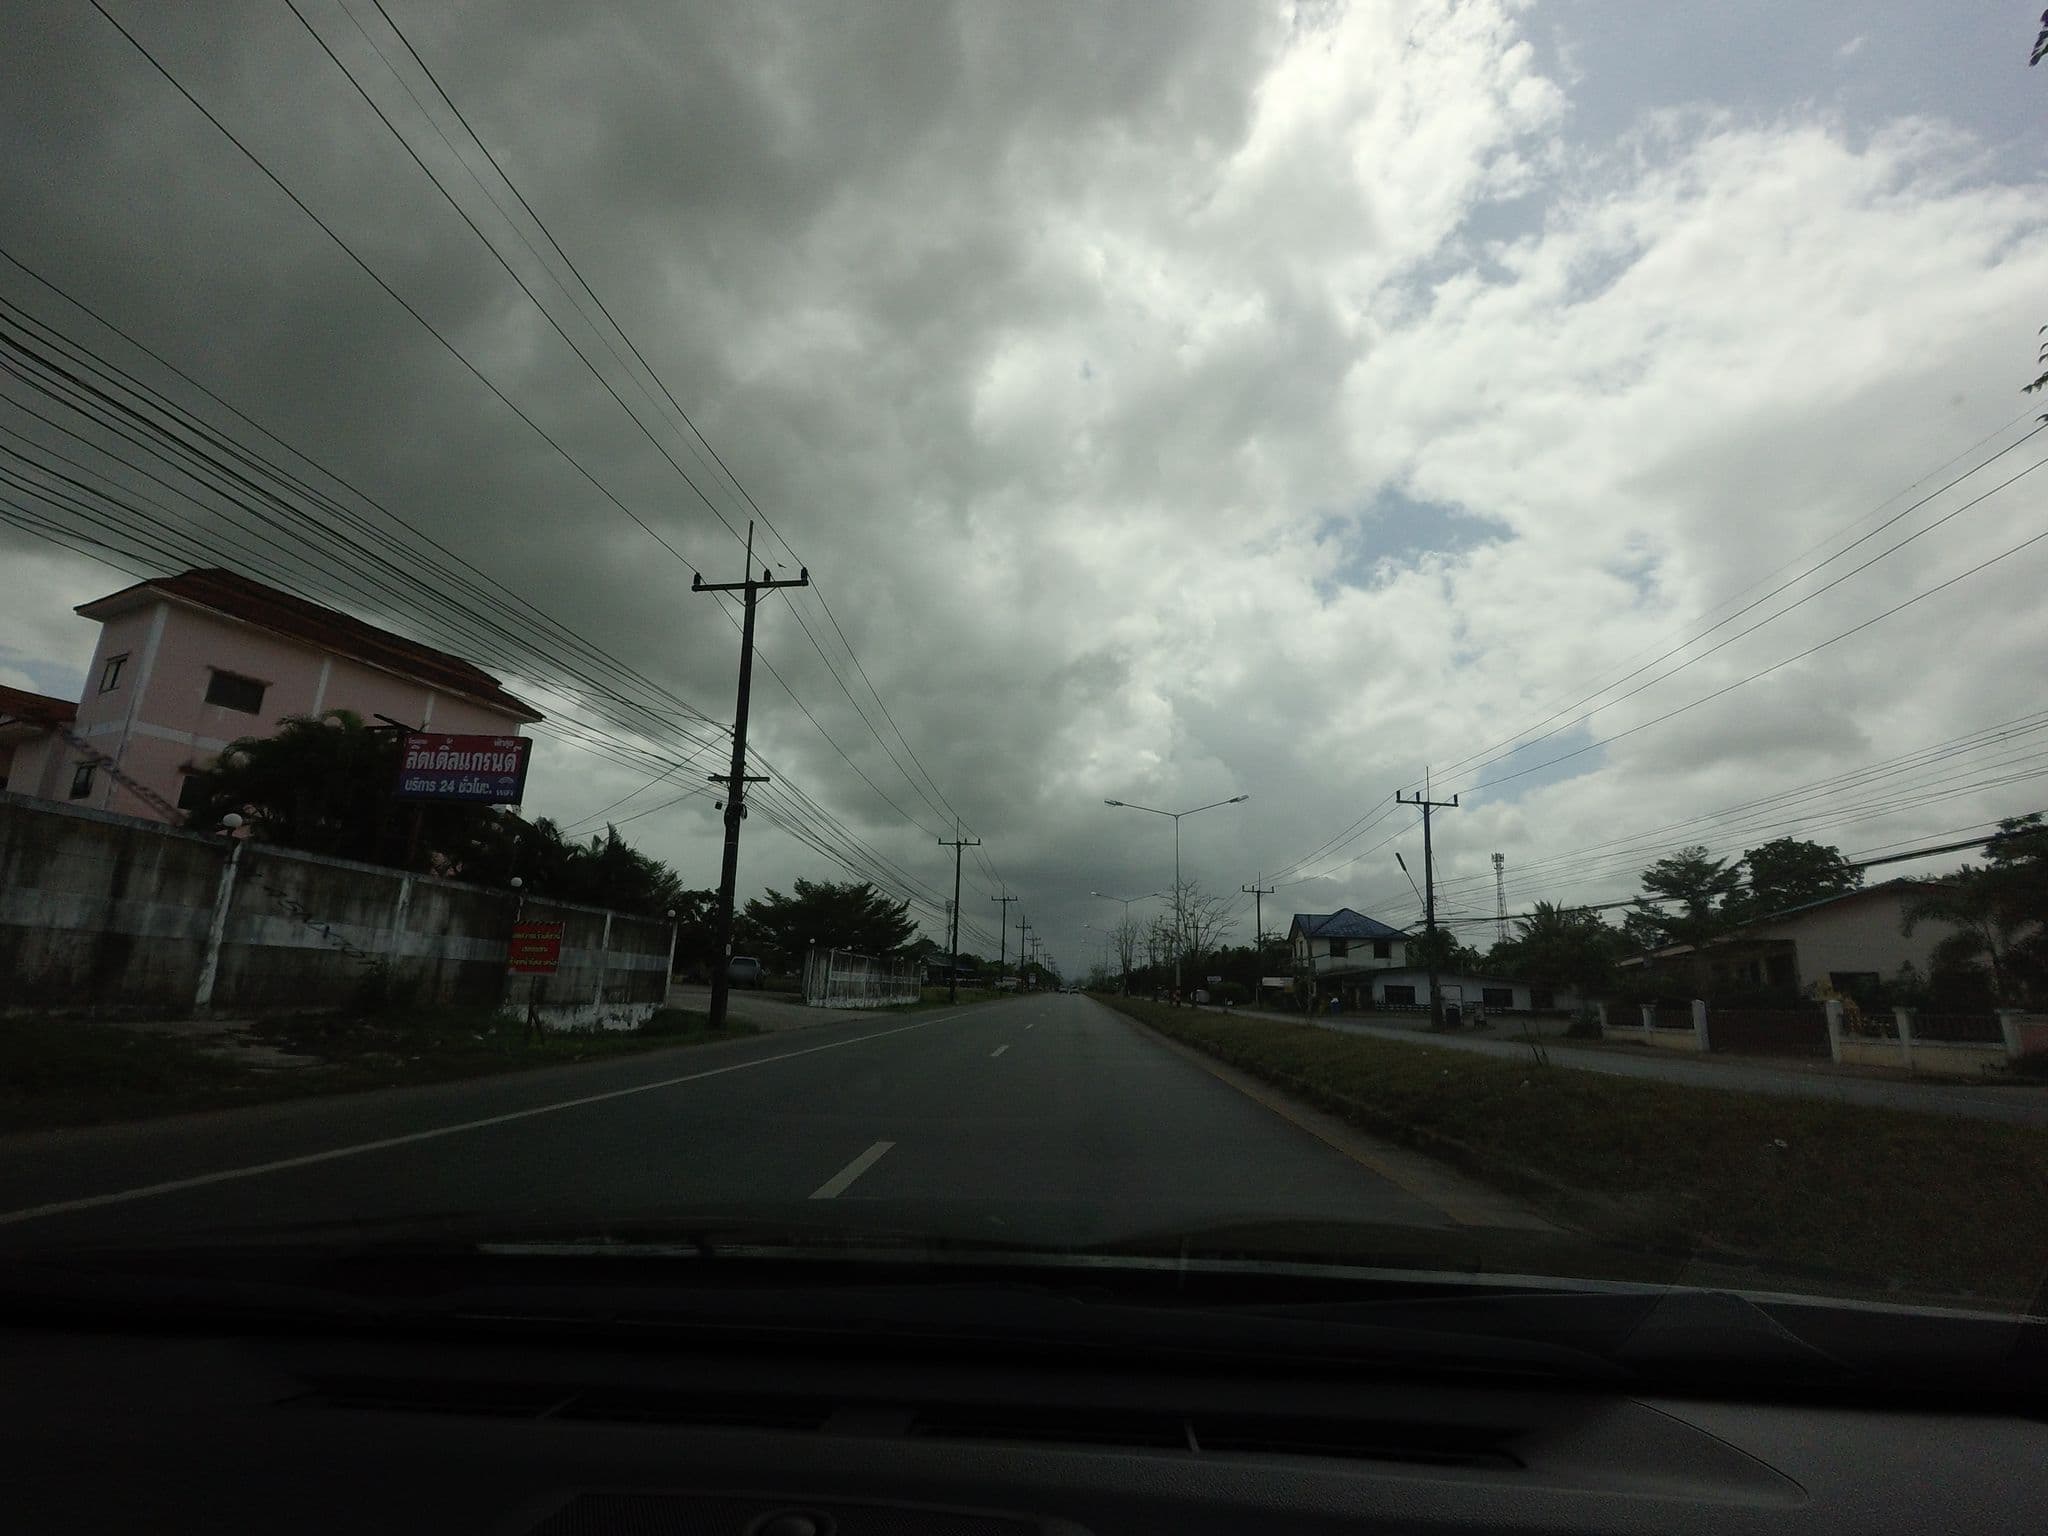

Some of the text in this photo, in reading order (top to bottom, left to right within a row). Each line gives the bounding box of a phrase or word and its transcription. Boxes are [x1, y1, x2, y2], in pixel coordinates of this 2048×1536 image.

[404, 777, 437, 793] บริการ
[440, 780, 455, 793] 24
